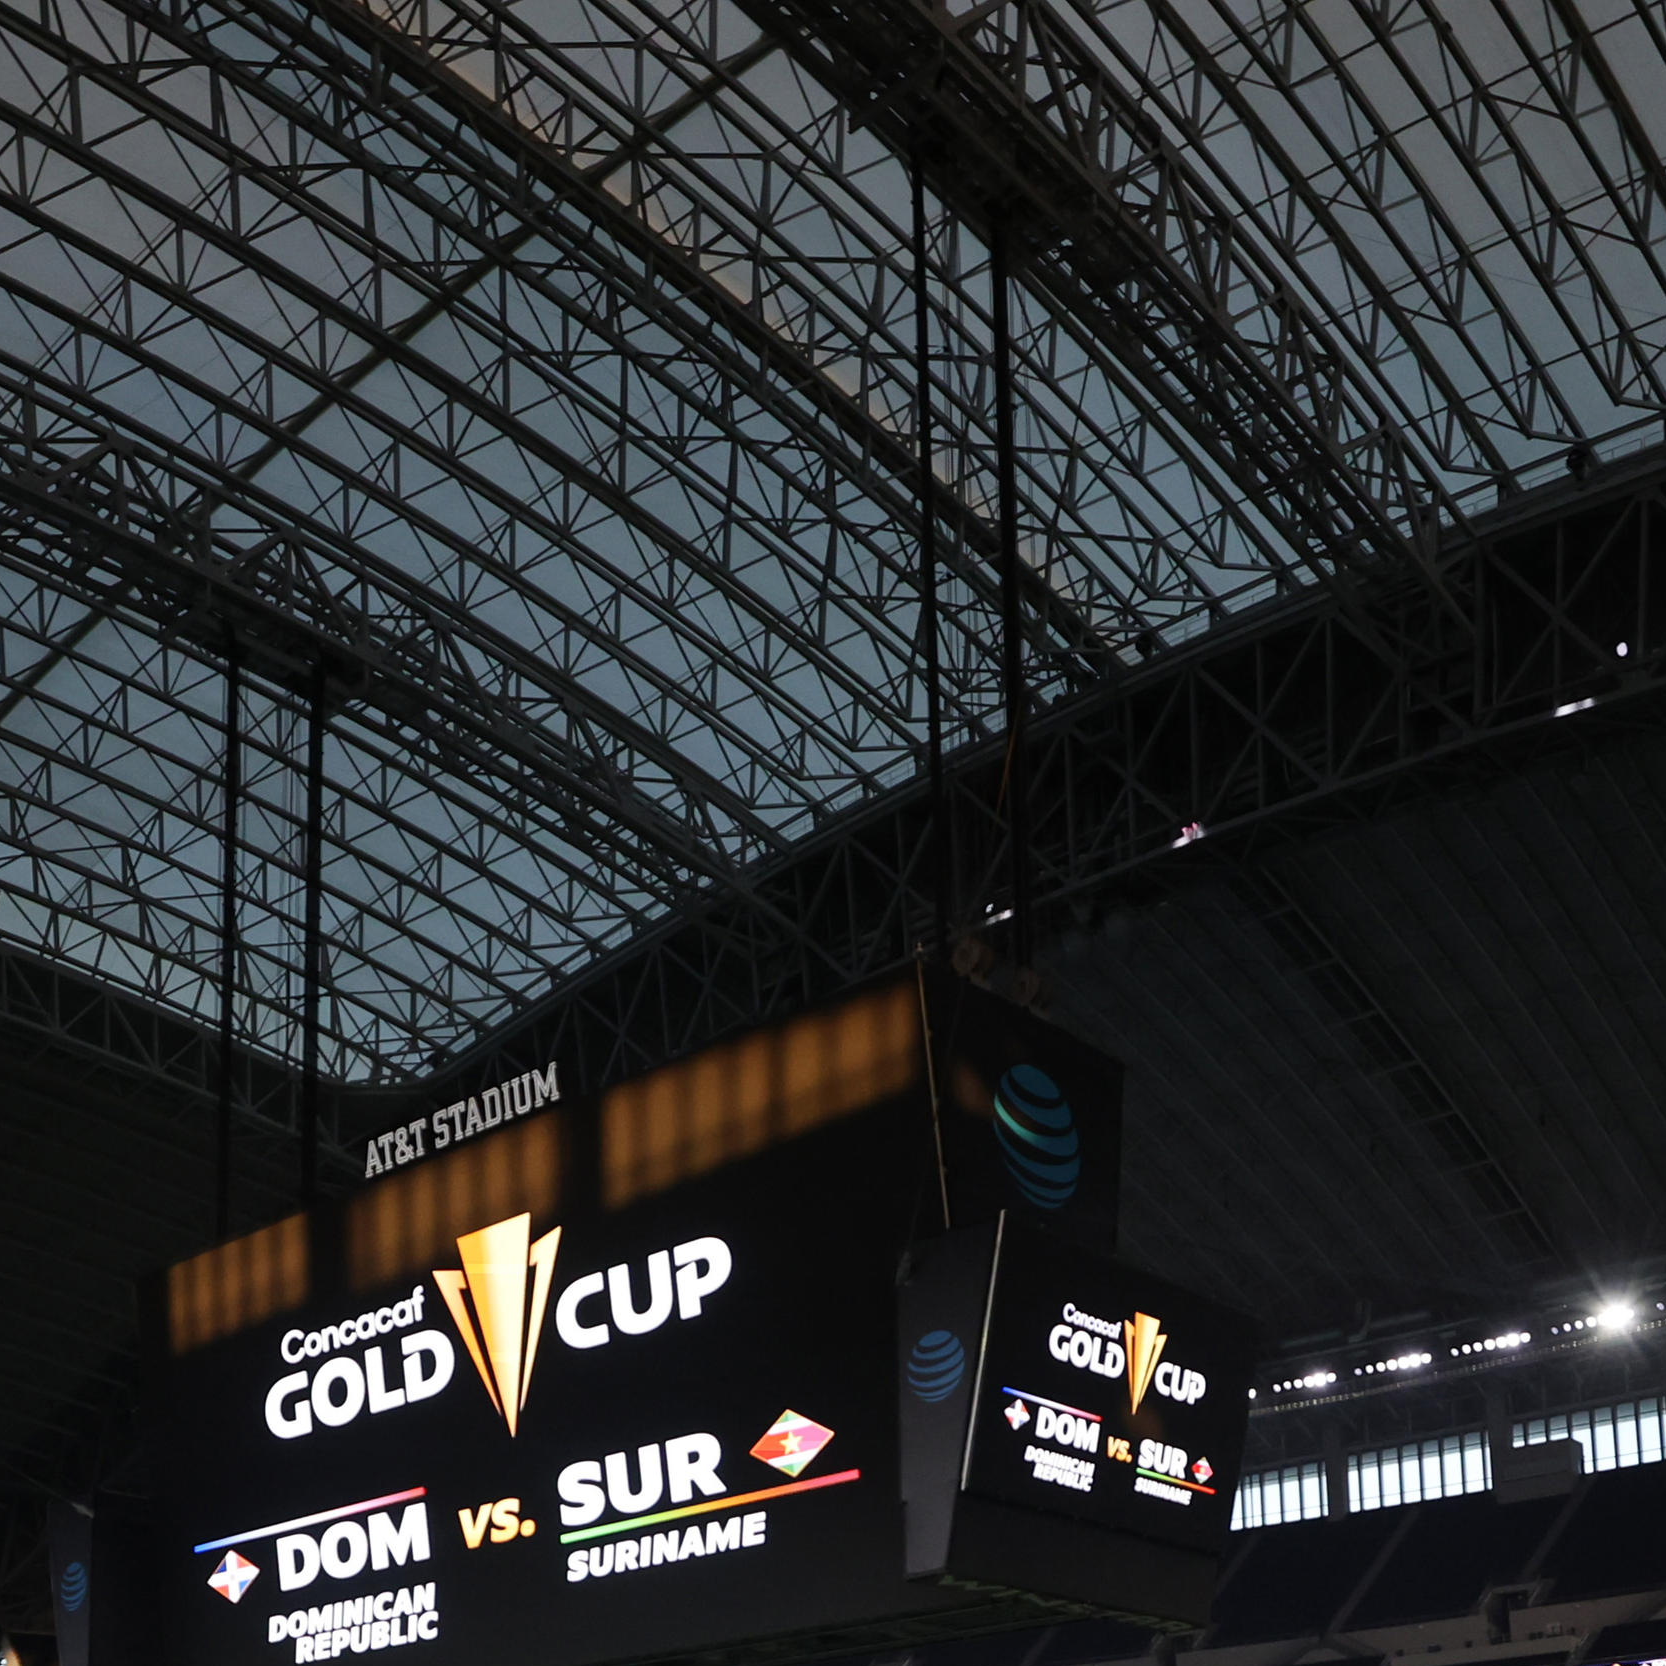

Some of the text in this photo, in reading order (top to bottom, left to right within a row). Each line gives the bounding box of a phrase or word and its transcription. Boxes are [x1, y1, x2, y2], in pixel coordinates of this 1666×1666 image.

[364, 1061, 561, 1178] AT&T STADIUM
[265, 1236, 732, 1439] GOLD CUP
[281, 1286, 425, 1364] Concacaf
[1062, 1302, 1123, 1340] Concacaf
[1048, 1324, 1206, 1405] GOLD CUP
[1024, 1445, 1095, 1477] DOMINICAN
[1032, 1462, 1093, 1493] REPUBLIC
[1035, 1406, 1101, 1453] DOM
[1137, 1438, 1188, 1479] SUR
[276, 1502, 431, 1592] DOM
[557, 1432, 727, 1527] SUR
[1134, 1476, 1192, 1506] SURINAME
[566, 1511, 767, 1583] SURINAME
[268, 1582, 436, 1643] DOMINICAN
[295, 1610, 439, 1665] REPUBLIC
